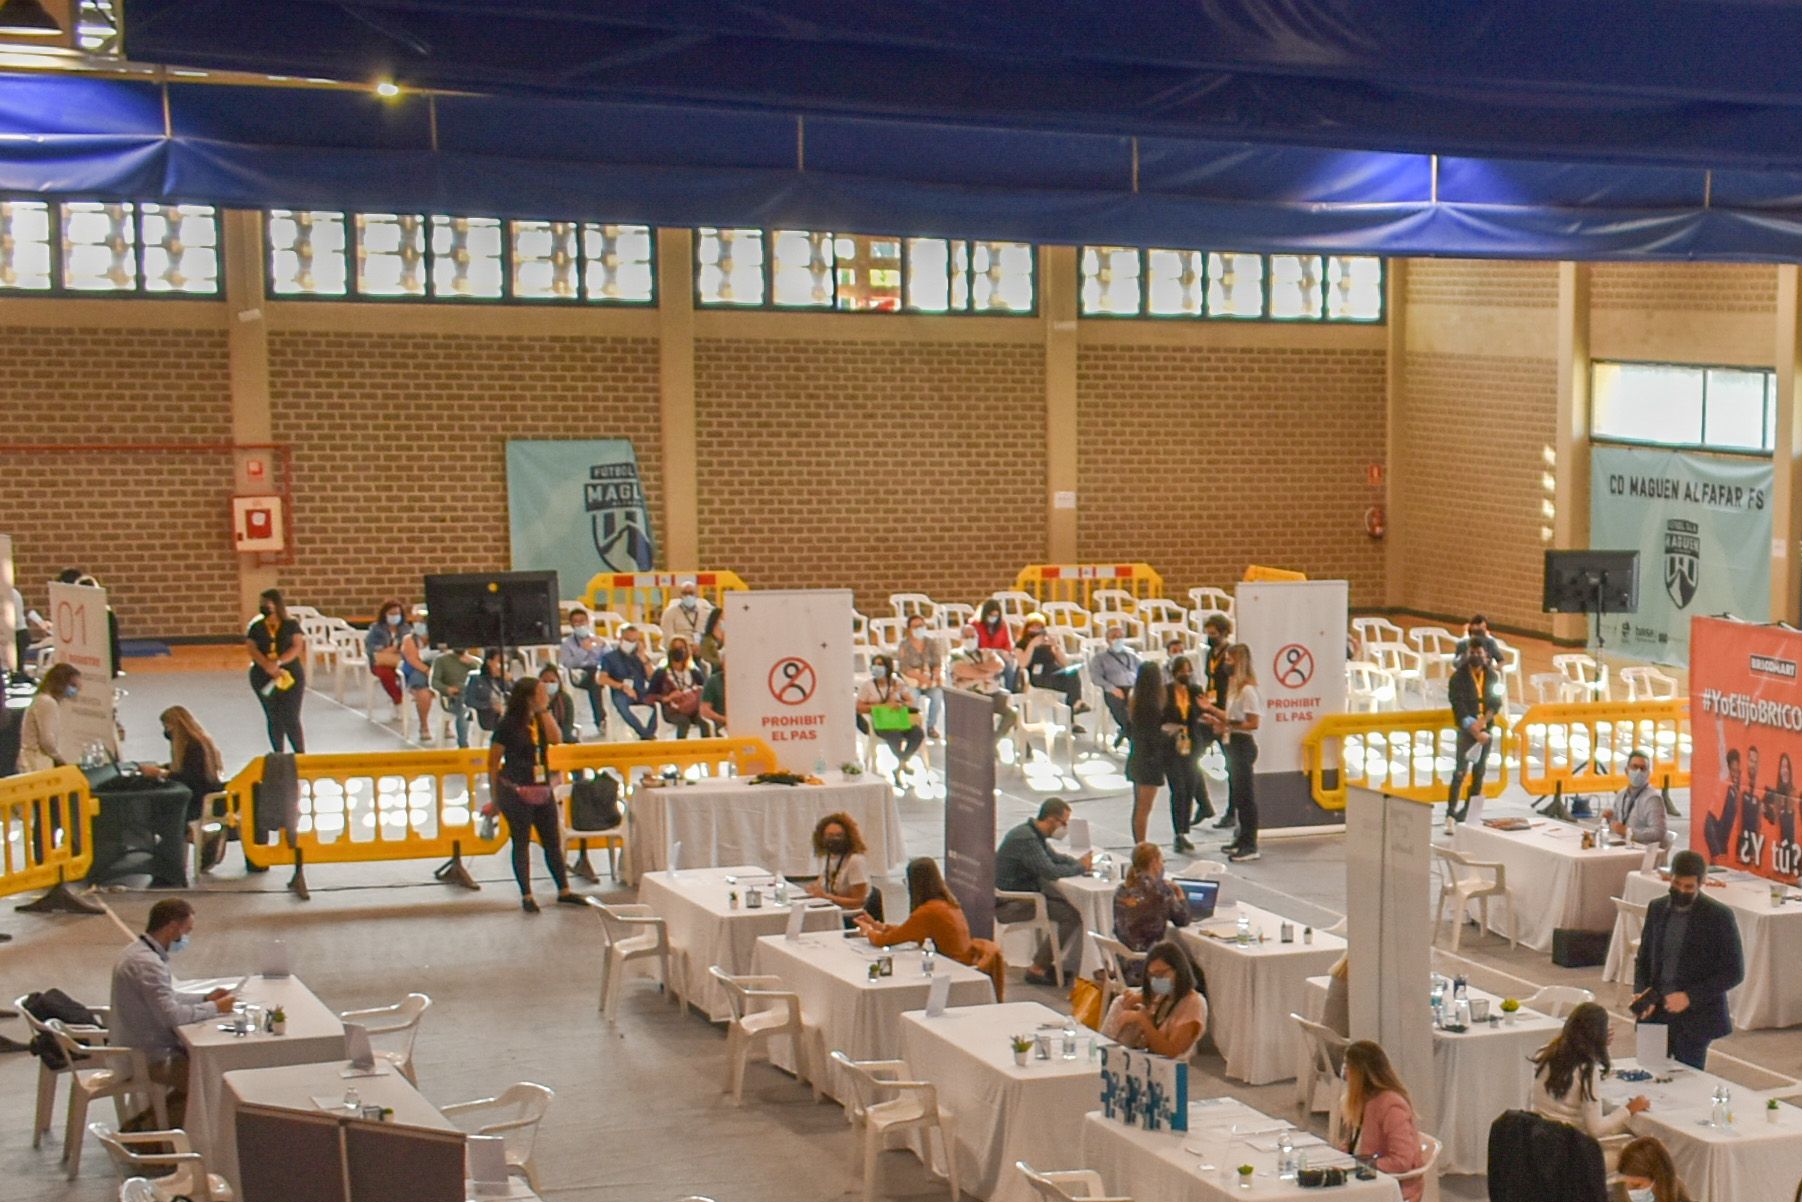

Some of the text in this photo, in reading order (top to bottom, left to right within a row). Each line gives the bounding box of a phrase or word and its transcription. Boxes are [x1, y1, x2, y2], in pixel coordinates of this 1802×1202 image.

[1610, 475, 1765, 510] CD MAGUEN ALFAFAR FS
[57, 600, 88, 646] 01
[1751, 657, 1796, 677] BRICOMART
[1266, 697, 1322, 709] PROHIBIT
[761, 714, 826, 727] PROHIBIT
[1275, 711, 1313, 722] EL PAS
[772, 730, 817, 741] EL PAS
[1740, 829, 1802, 877] ¿Y tú?
